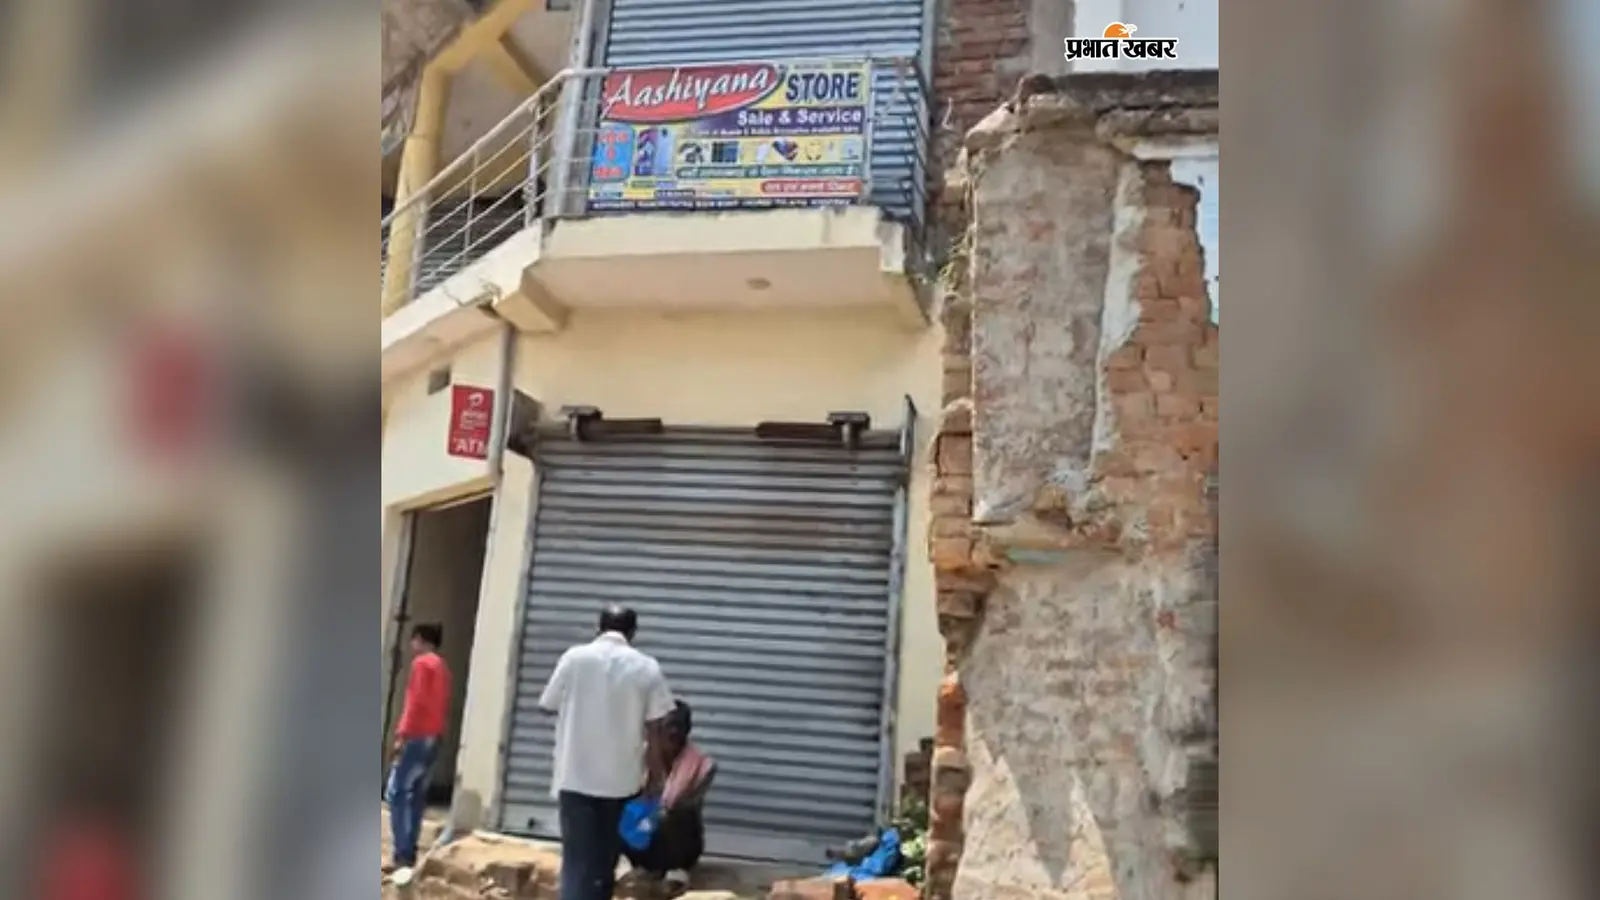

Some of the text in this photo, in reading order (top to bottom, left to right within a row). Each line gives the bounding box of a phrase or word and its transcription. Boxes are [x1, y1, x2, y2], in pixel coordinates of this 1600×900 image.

[600, 65, 861, 118] Aashiyana STORE
[737, 107, 862, 127] Sale & Service
